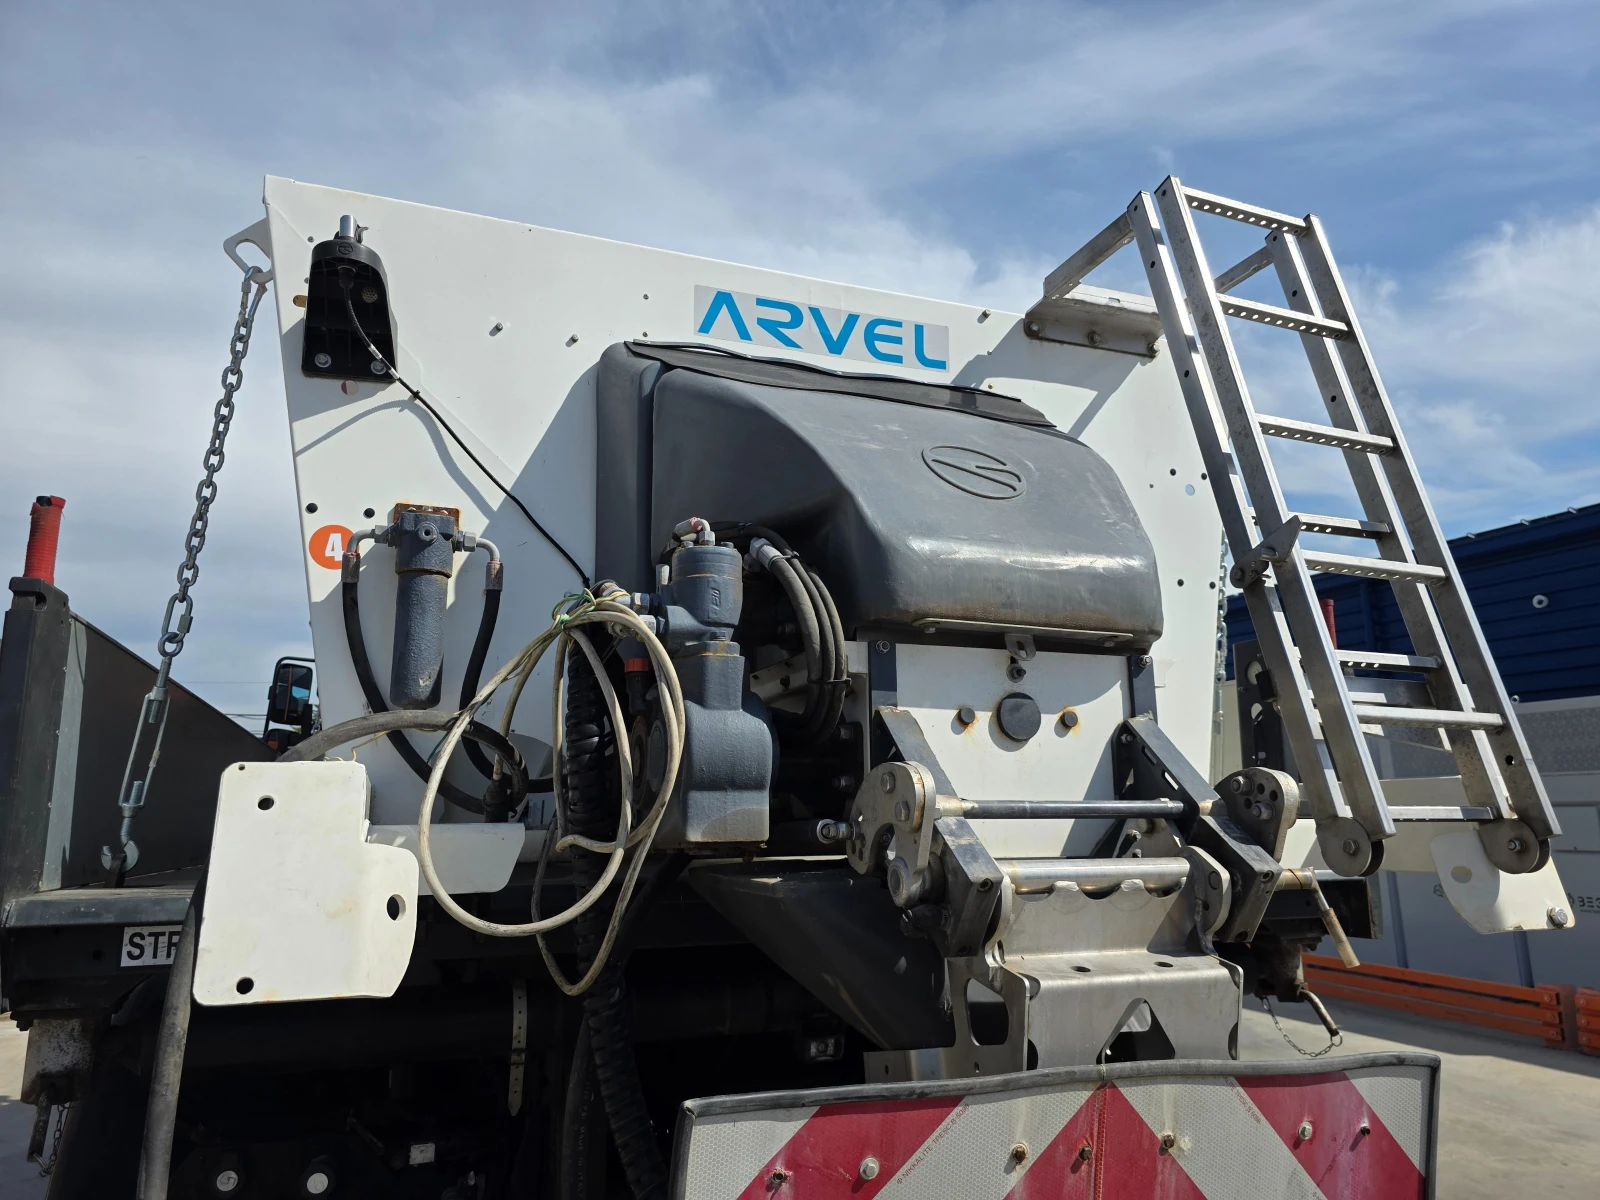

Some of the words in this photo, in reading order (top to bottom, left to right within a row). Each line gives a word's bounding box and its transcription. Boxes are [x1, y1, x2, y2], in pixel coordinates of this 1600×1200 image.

[698, 290, 947, 371] ARVEL
[325, 533, 343, 562] 4
[902, 1144, 934, 1178] NIKKALITE
